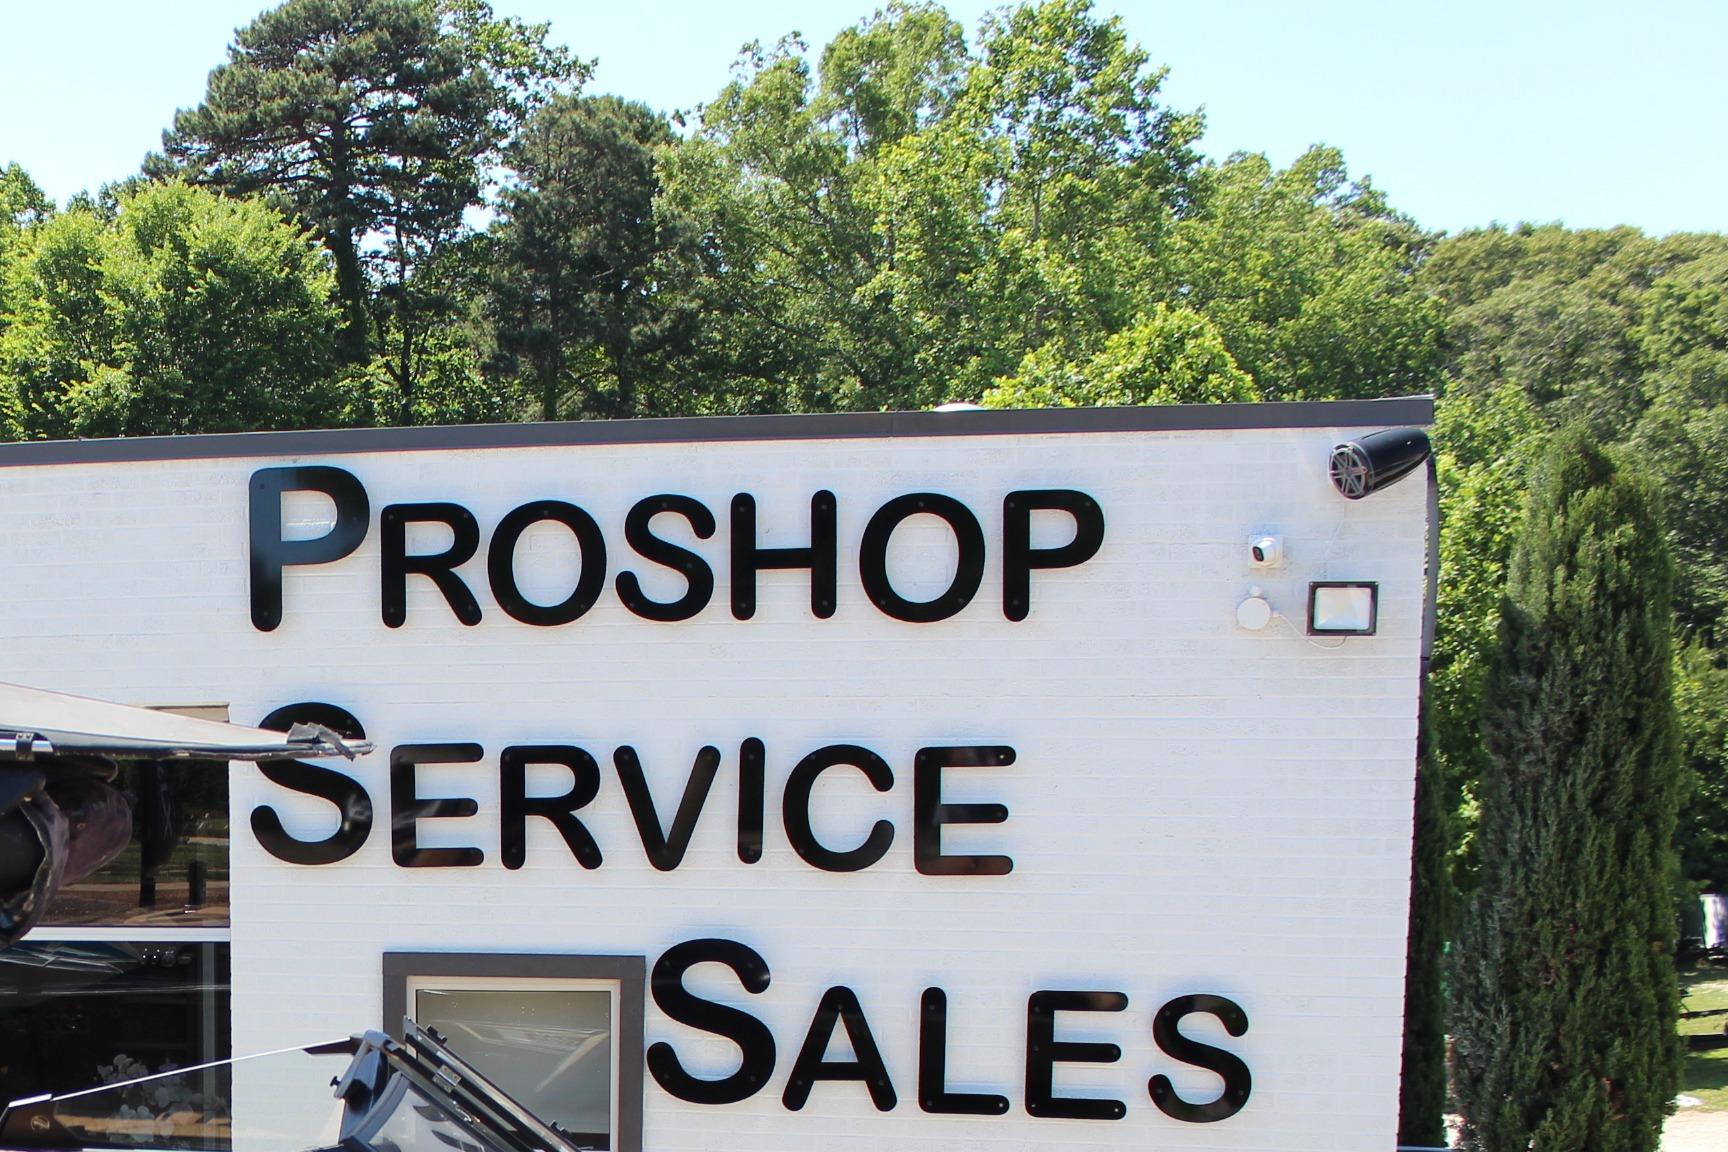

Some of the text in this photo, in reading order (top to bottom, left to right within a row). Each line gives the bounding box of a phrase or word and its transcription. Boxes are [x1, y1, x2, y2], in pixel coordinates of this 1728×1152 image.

[248, 465, 1105, 632] PROSHOP
[250, 701, 1017, 876] SERVICE
[646, 938, 1252, 1123] SALES
